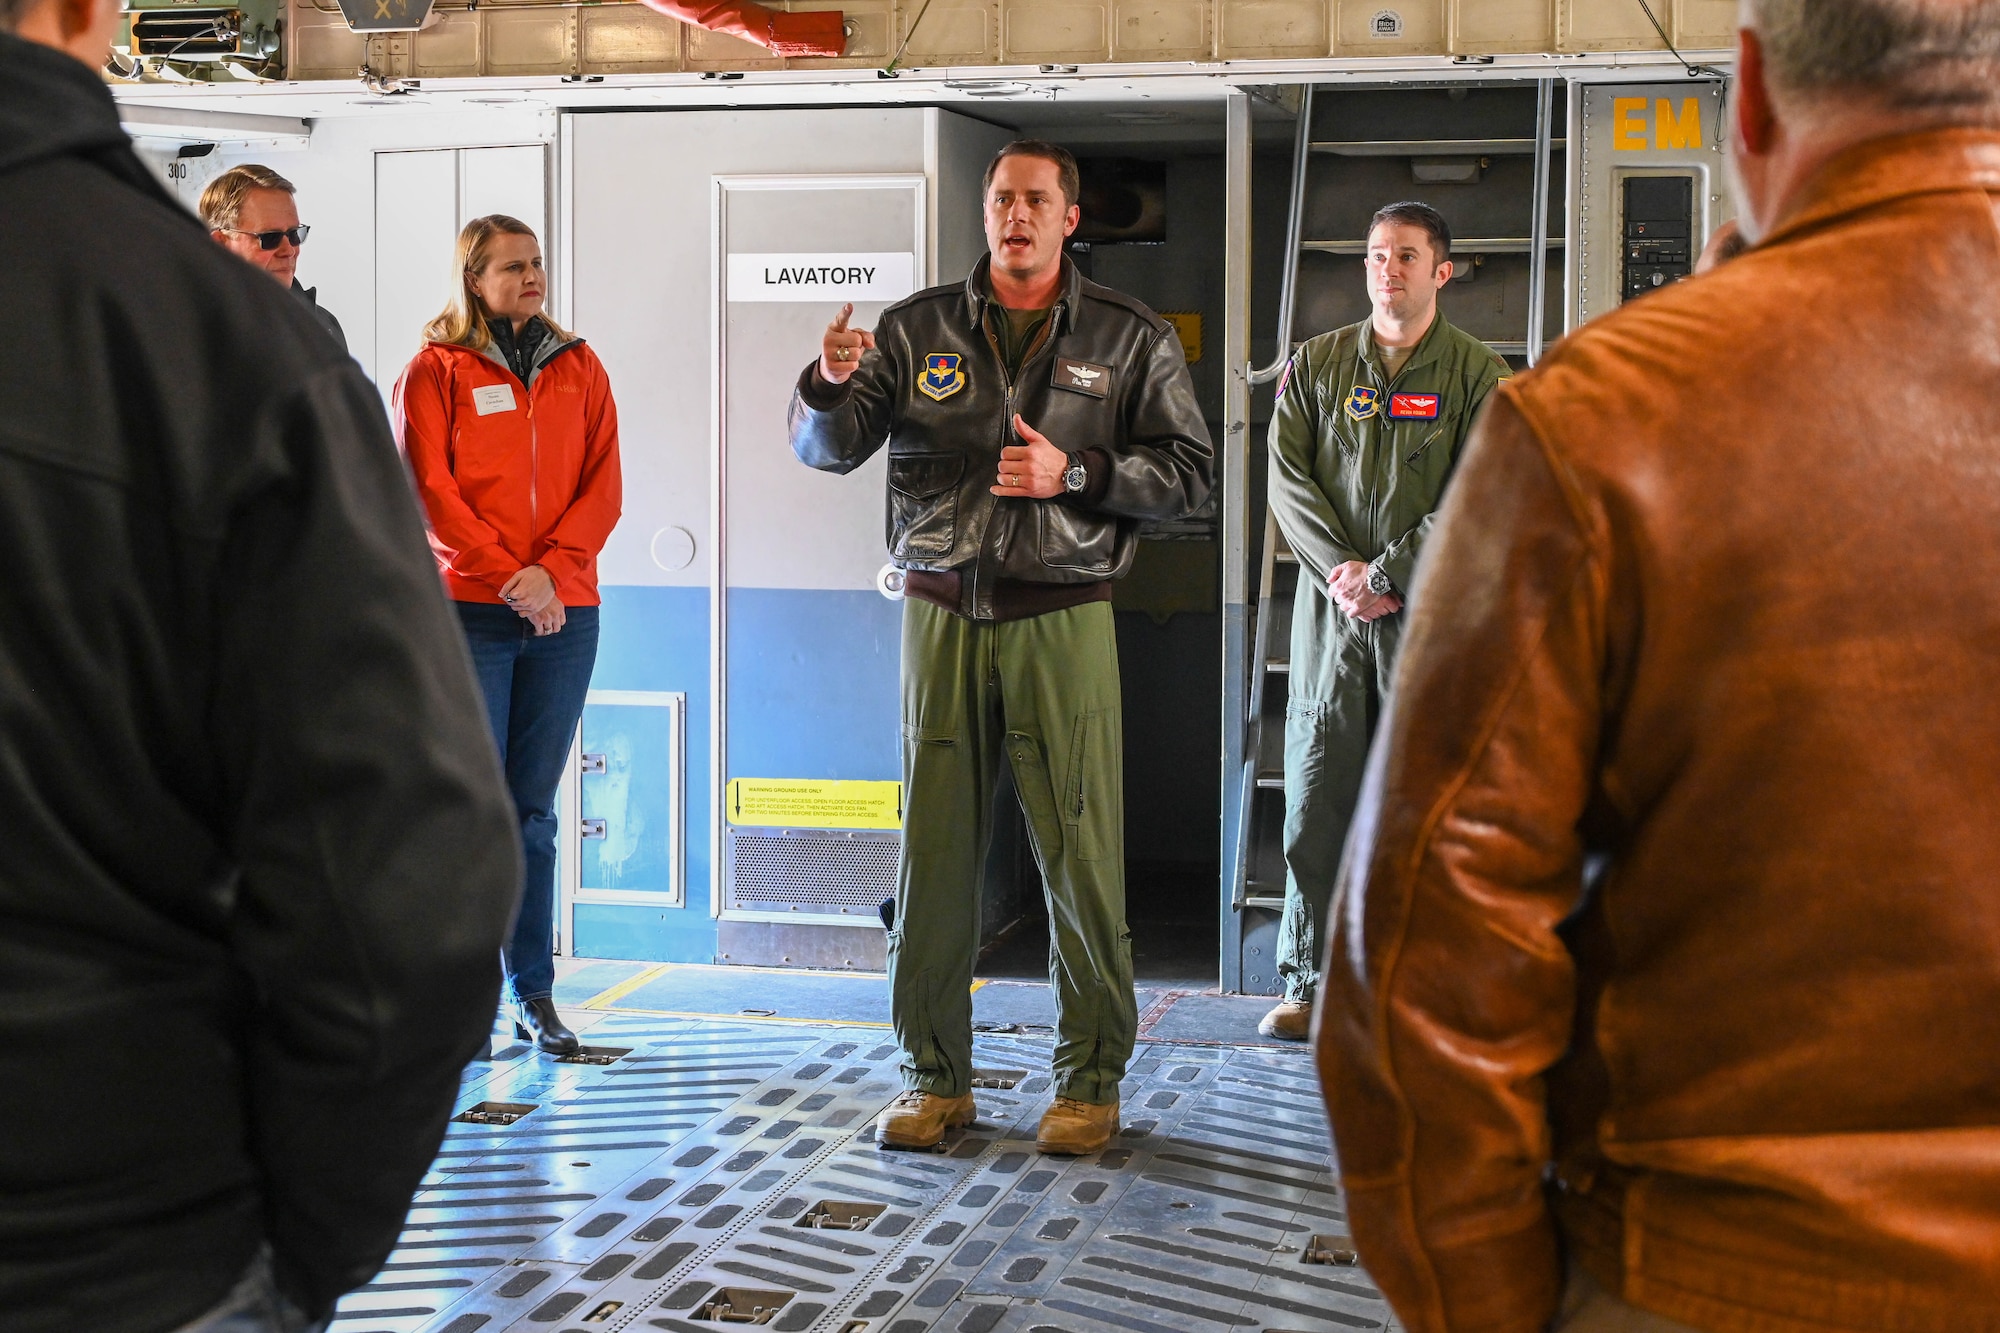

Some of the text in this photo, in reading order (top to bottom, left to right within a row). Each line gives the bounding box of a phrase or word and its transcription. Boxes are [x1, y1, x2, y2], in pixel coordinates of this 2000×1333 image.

[1614, 97, 1702, 150] EM
[168, 163, 187, 179] 300
[765, 267, 876, 284] LAVATORY
